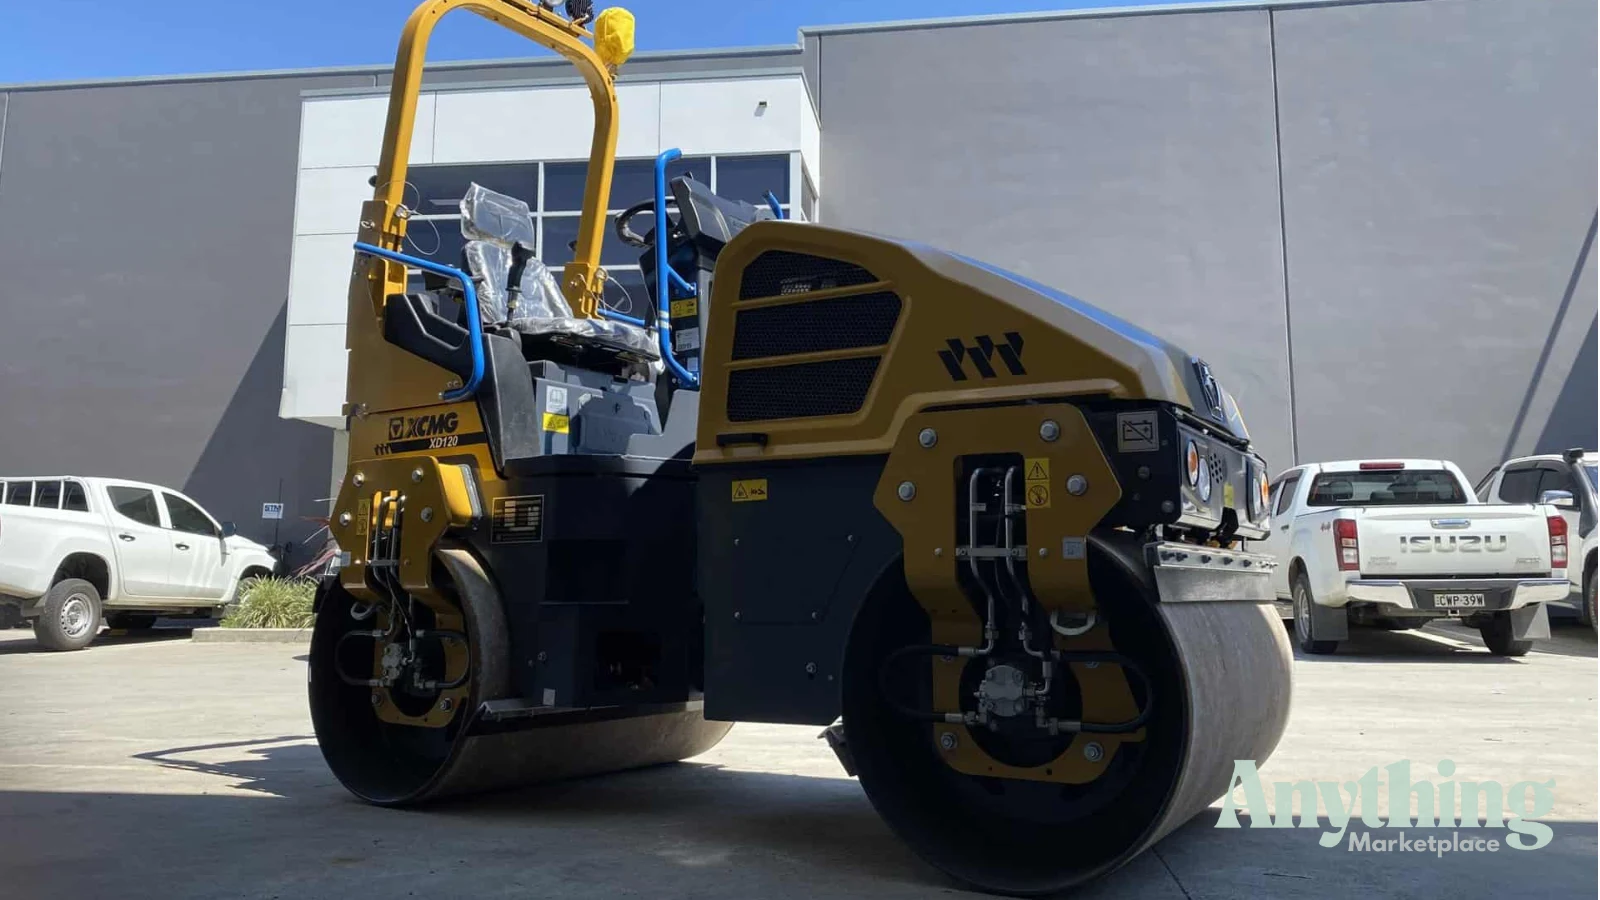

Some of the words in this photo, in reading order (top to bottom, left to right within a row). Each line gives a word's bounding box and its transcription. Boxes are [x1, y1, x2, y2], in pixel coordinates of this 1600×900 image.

[405, 412, 459, 438] XCMG
[429, 435, 459, 449] XD120
[1399, 535, 1507, 553] ISUZU
